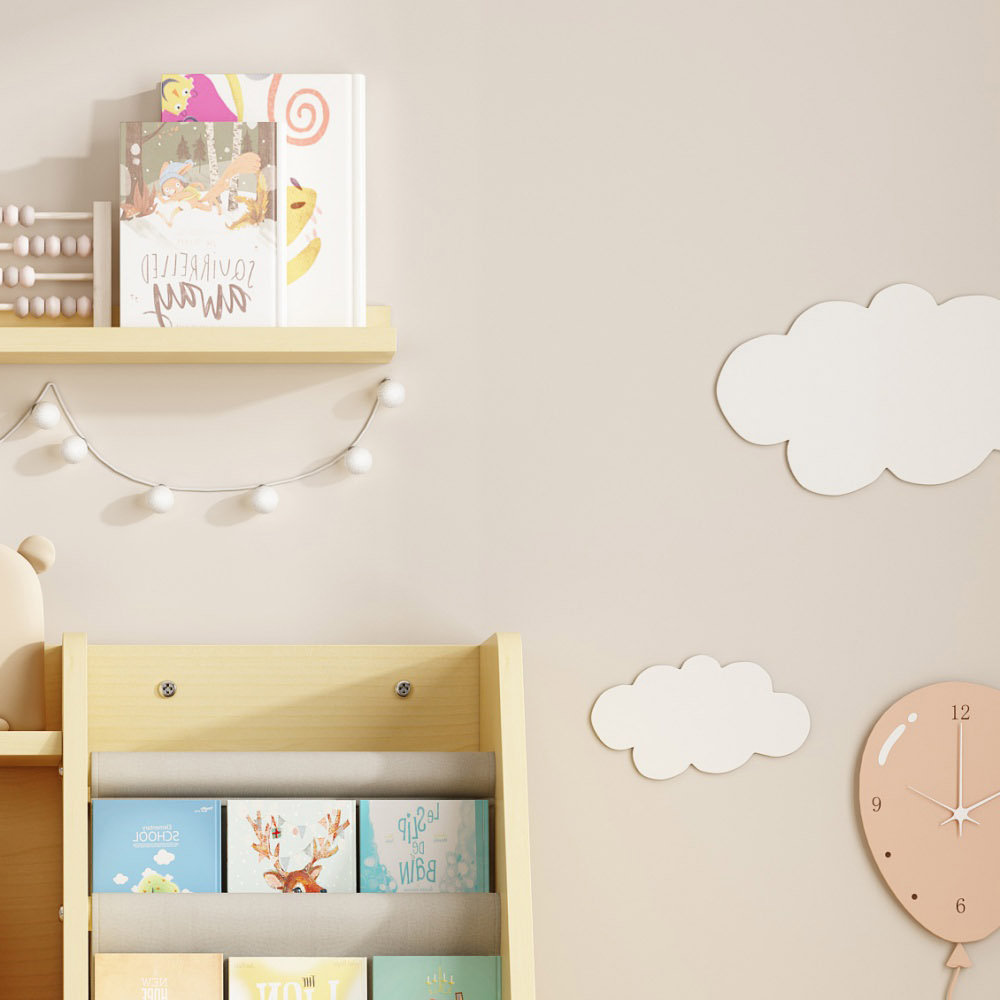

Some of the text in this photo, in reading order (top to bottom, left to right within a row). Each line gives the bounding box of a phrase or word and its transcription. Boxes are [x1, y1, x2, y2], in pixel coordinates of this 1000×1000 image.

[951, 704, 970, 721] 12
[871, 796, 882, 812] 9
[955, 898, 966, 914] 6
